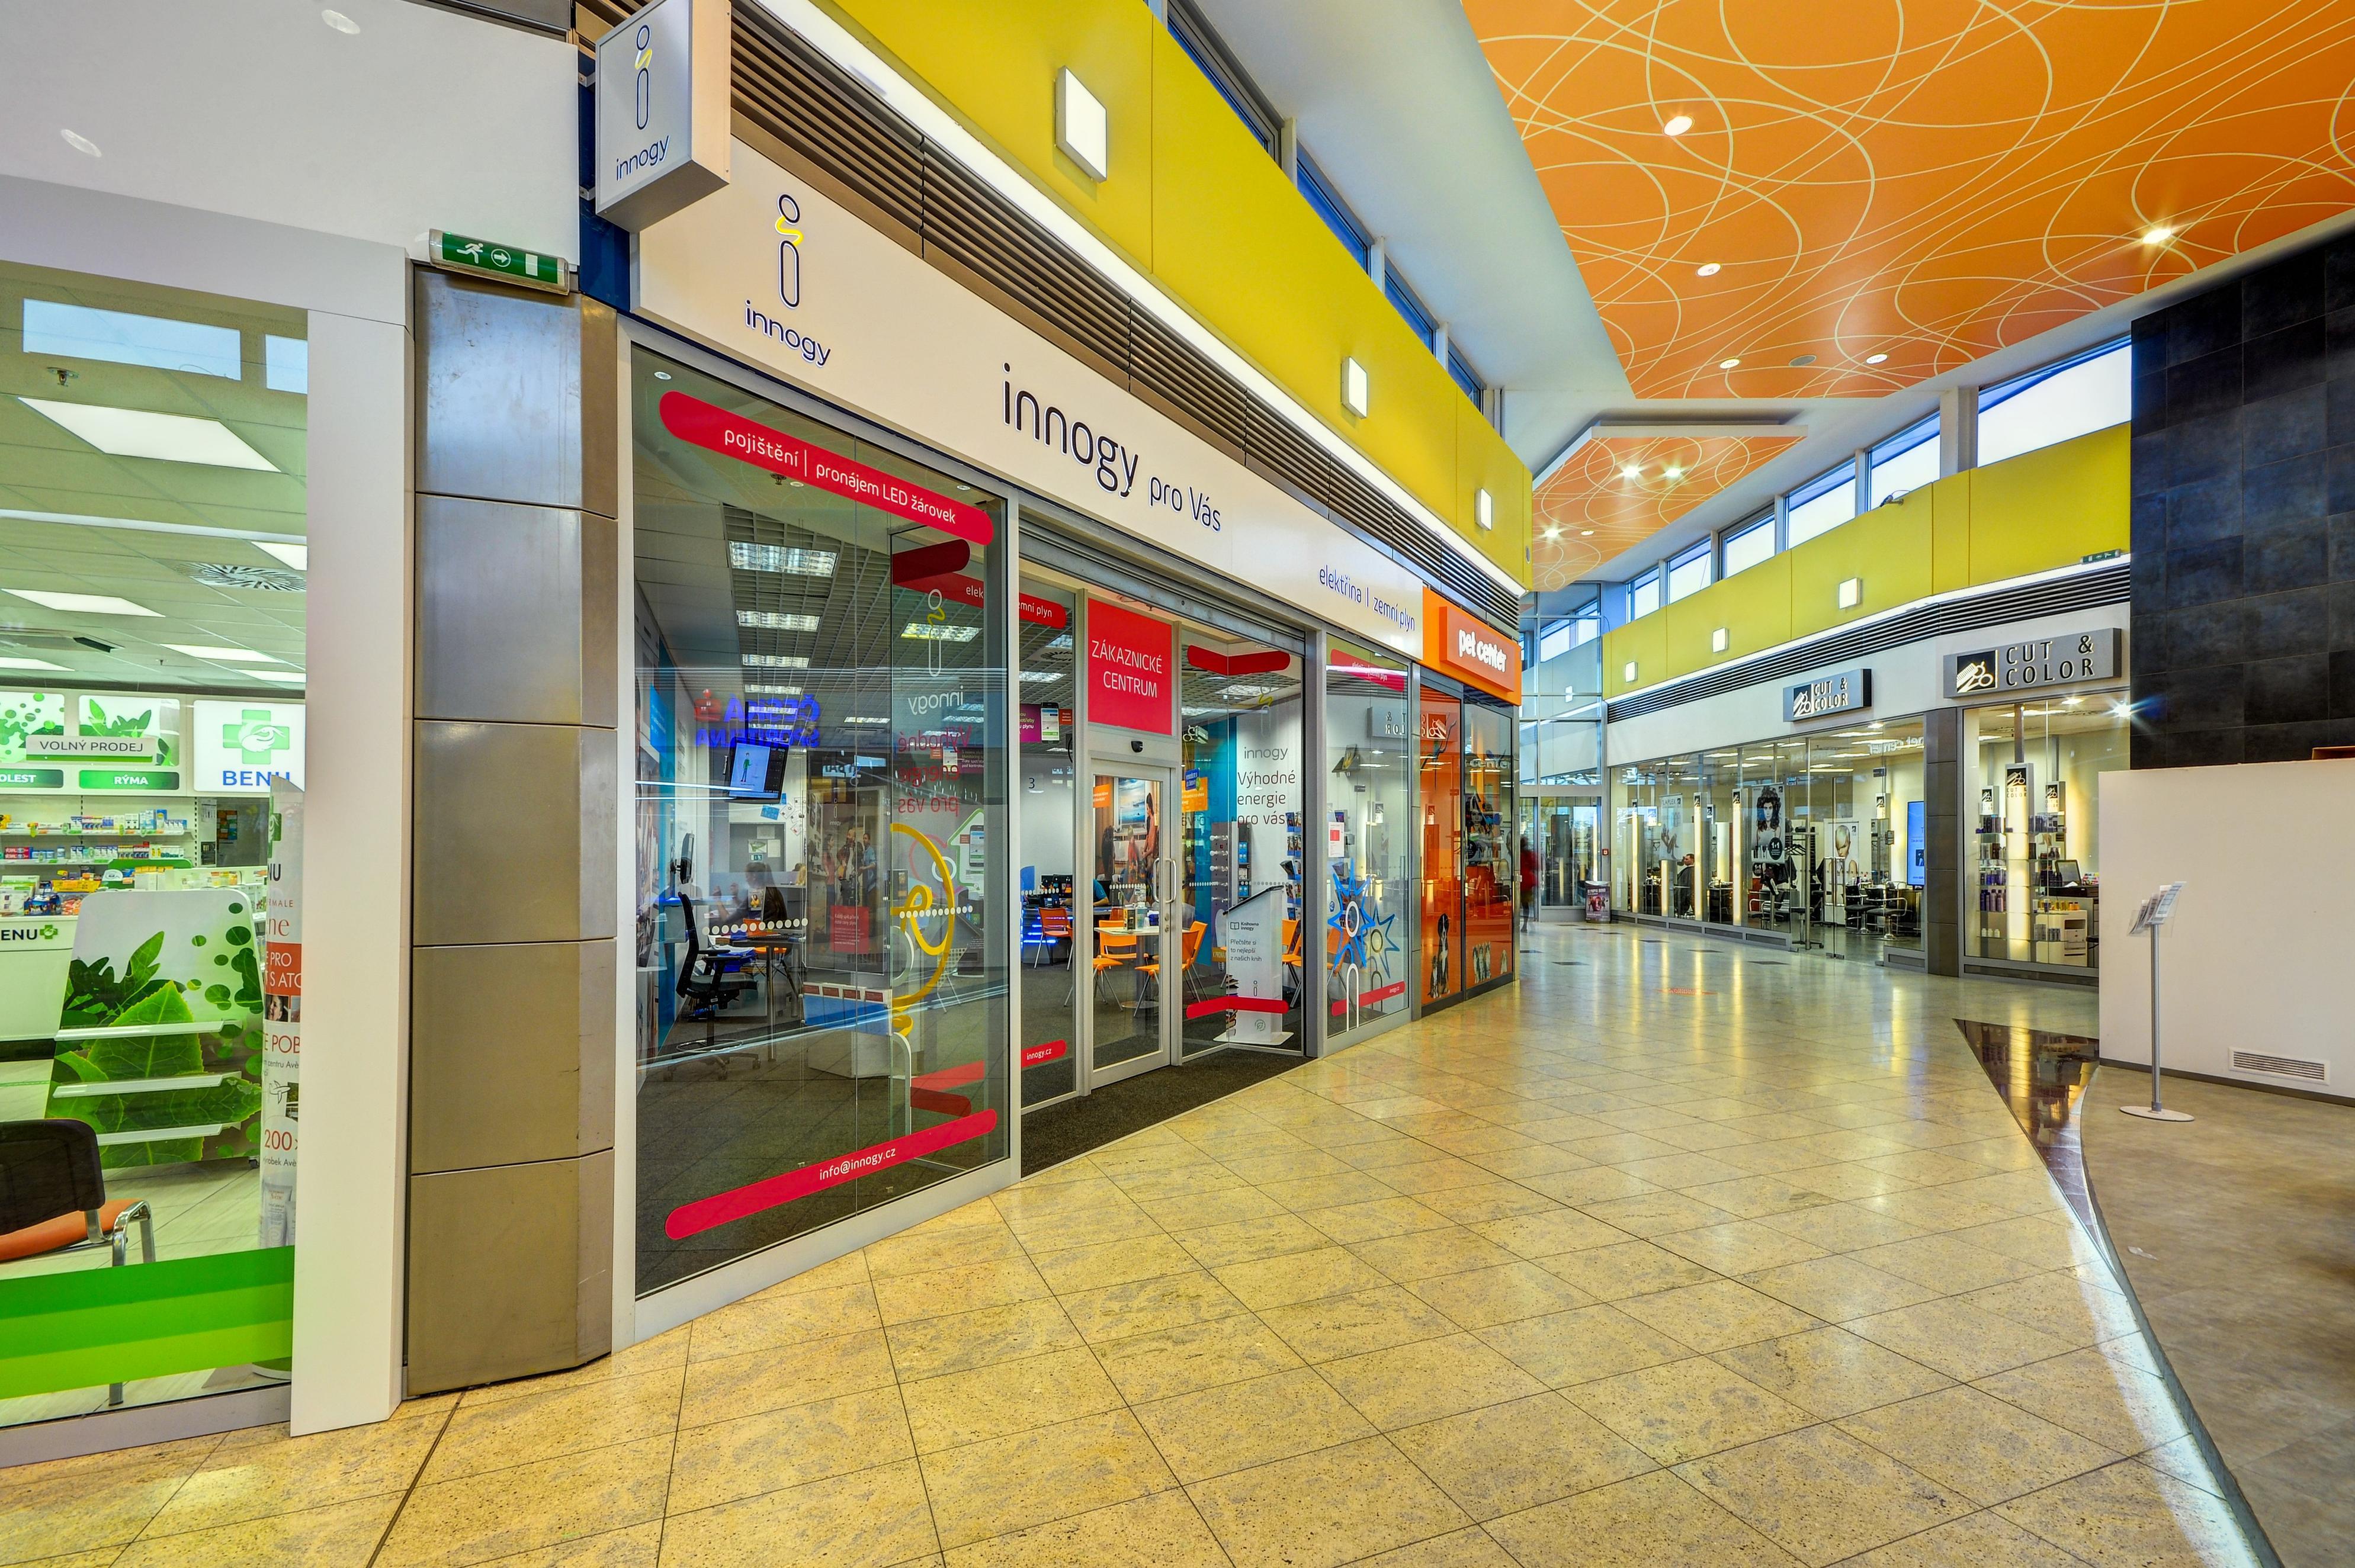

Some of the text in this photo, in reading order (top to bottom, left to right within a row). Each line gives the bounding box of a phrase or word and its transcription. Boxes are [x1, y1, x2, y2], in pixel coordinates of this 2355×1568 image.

[615, 134, 670, 181] innogy
[745, 300, 831, 367] innogy
[1002, 362, 1221, 532] innogy pro Vás
[724, 429, 799, 467] pojištění
[816, 464, 879, 496] pronájem
[883, 484, 908, 506] LED
[911, 494, 955, 524] žárovek
[1319, 565, 1362, 603] elektřina
[1373, 603, 1398, 622] zemní
[1399, 608, 1415, 632] plyn
[1037, 605, 1052, 618] plyn
[1092, 639, 1163, 674] ZÁKAZNICKÉ
[1458, 629, 1507, 673] pet center
[2006, 635, 2093, 665] CUT &
[2006, 658, 2095, 686] COLOR
[1103, 671, 1158, 699] CENTRUM
[1814, 677, 1847, 696] CUT &
[1814, 692, 1849, 711] COLOR
[40, 740, 143, 752] VOLNÝ PRODEJ
[1244, 747, 1288, 760] innogy
[114, 774, 148, 785] RÝMA
[1237, 769, 1296, 789] Výhodné
[1237, 792, 1286, 808] energie
[1263, 811, 1285, 825] vás
[271, 952, 291, 967] PRO
[1026, 1048, 1052, 1061] innogy.cz
[264, 1129, 293, 1151] 200
[819, 1146, 896, 1181] info@innogy.cz
